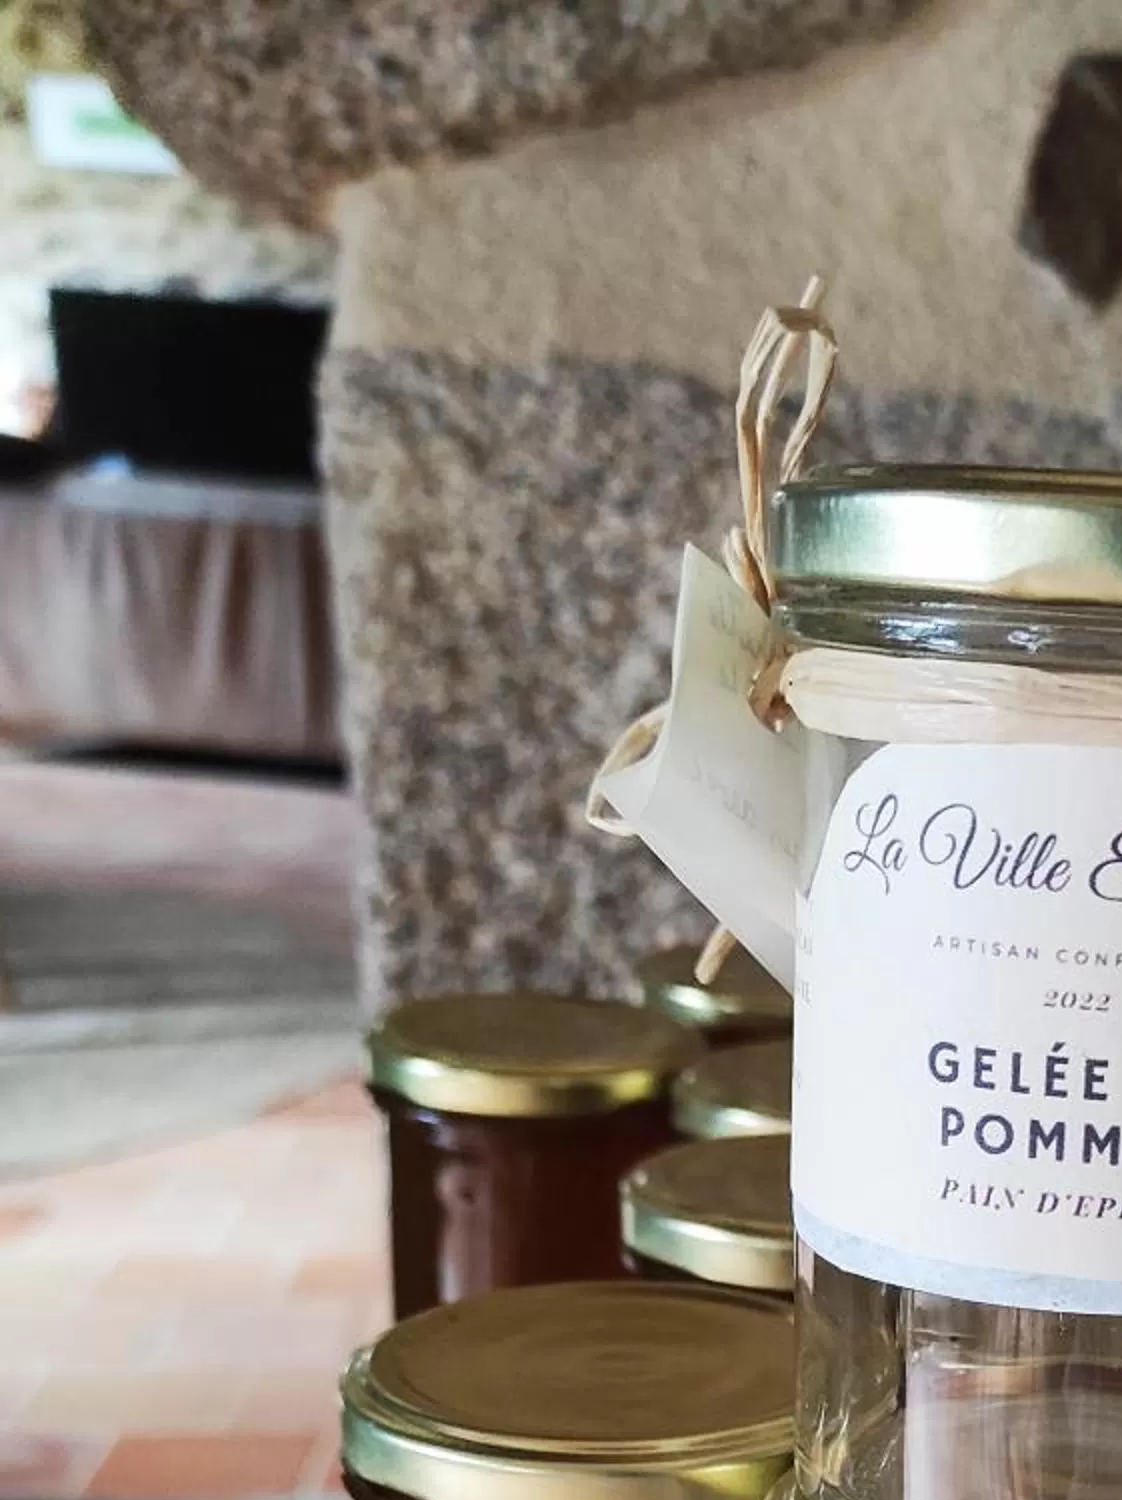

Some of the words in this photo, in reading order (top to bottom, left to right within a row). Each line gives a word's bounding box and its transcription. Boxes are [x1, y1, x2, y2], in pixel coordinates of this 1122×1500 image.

[844, 794, 908, 896] La
[919, 803, 1072, 893] Ville
[932, 934, 1040, 961] ARTISAN
[1043, 988, 1112, 1012] 2022
[928, 1041, 1109, 1102] GELÉE
[941, 1178, 1025, 1210] PAIN
